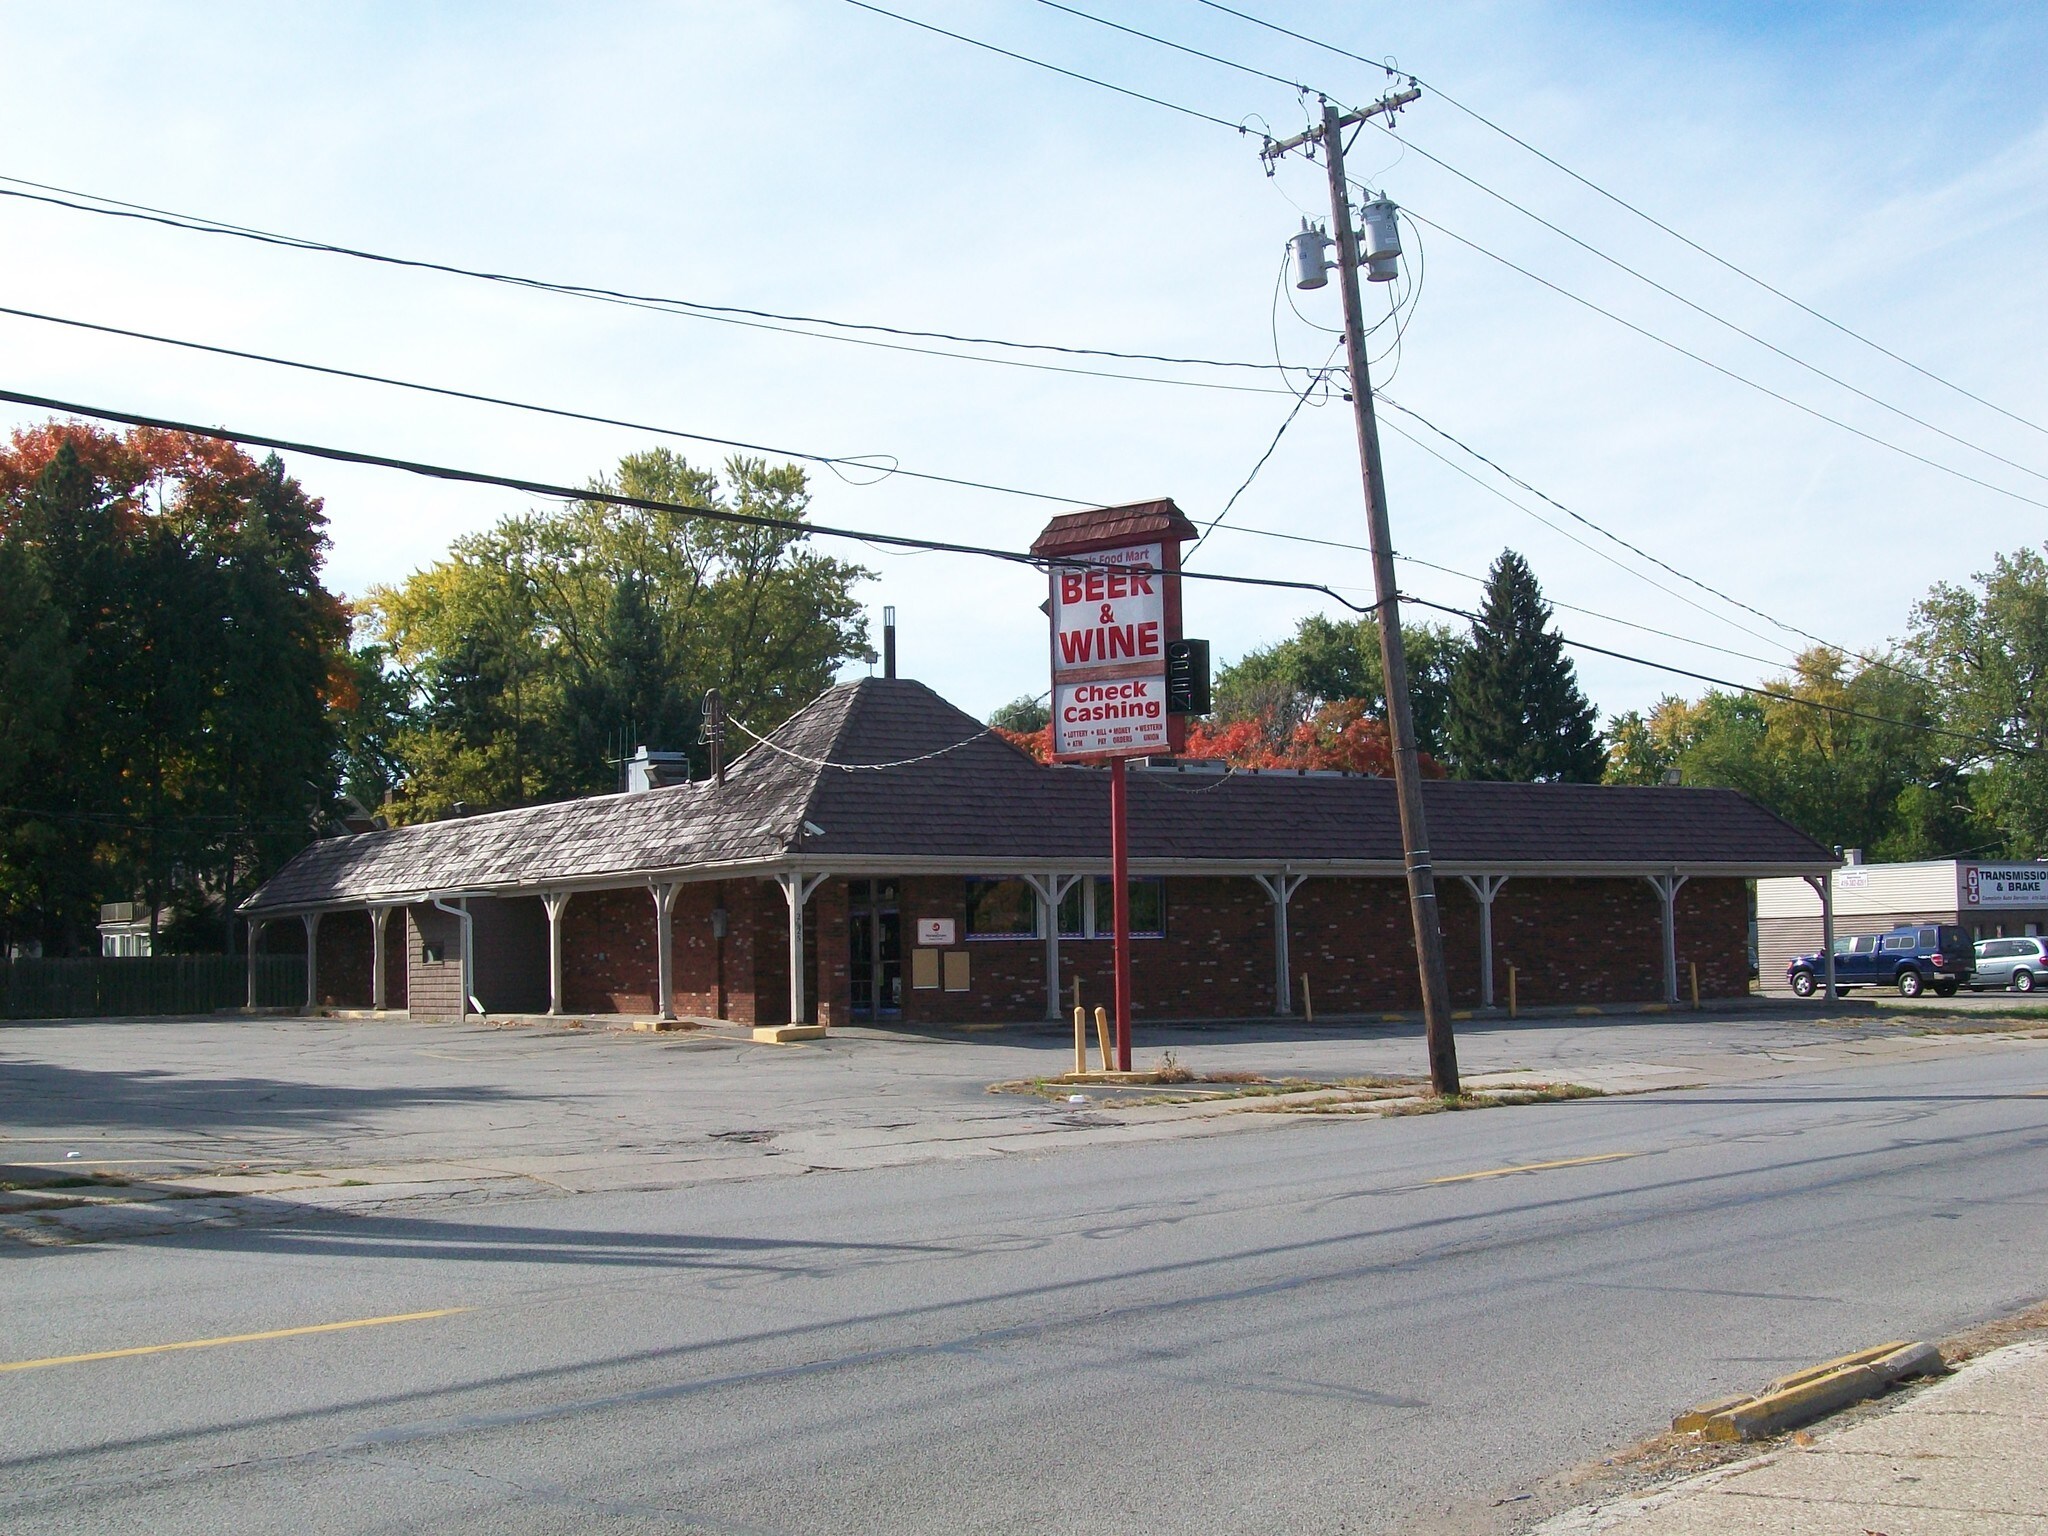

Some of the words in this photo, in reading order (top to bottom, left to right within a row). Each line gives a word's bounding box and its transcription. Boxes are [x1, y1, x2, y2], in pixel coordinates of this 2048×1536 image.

[1099, 553, 1123, 564] Food
[1125, 548, 1149, 561] Mart
[1062, 562, 1154, 604] BEER
[1099, 603, 1115, 624] &
[1059, 621, 1159, 664] WINE
[1074, 680, 1148, 704] Check
[1063, 700, 1160, 723] Cashing
[1067, 730, 1088, 739] LOTTERY
[1096, 728, 1107, 736] BILL
[1113, 726, 1131, 735] MONEY
[1139, 723, 1163, 732] WESTERN
[1072, 739, 1083, 747] ATM
[1097, 738, 1107, 746] PAY
[1112, 735, 1133, 744] ORDERS
[1143, 733, 1160, 741] UNION
[1968, 870, 1979, 902] AUTO
[1979, 871, 2048, 881] TRANSMISSIO
[1996, 882, 2004, 892] &
[2008, 882, 2041, 892] BRAKE
